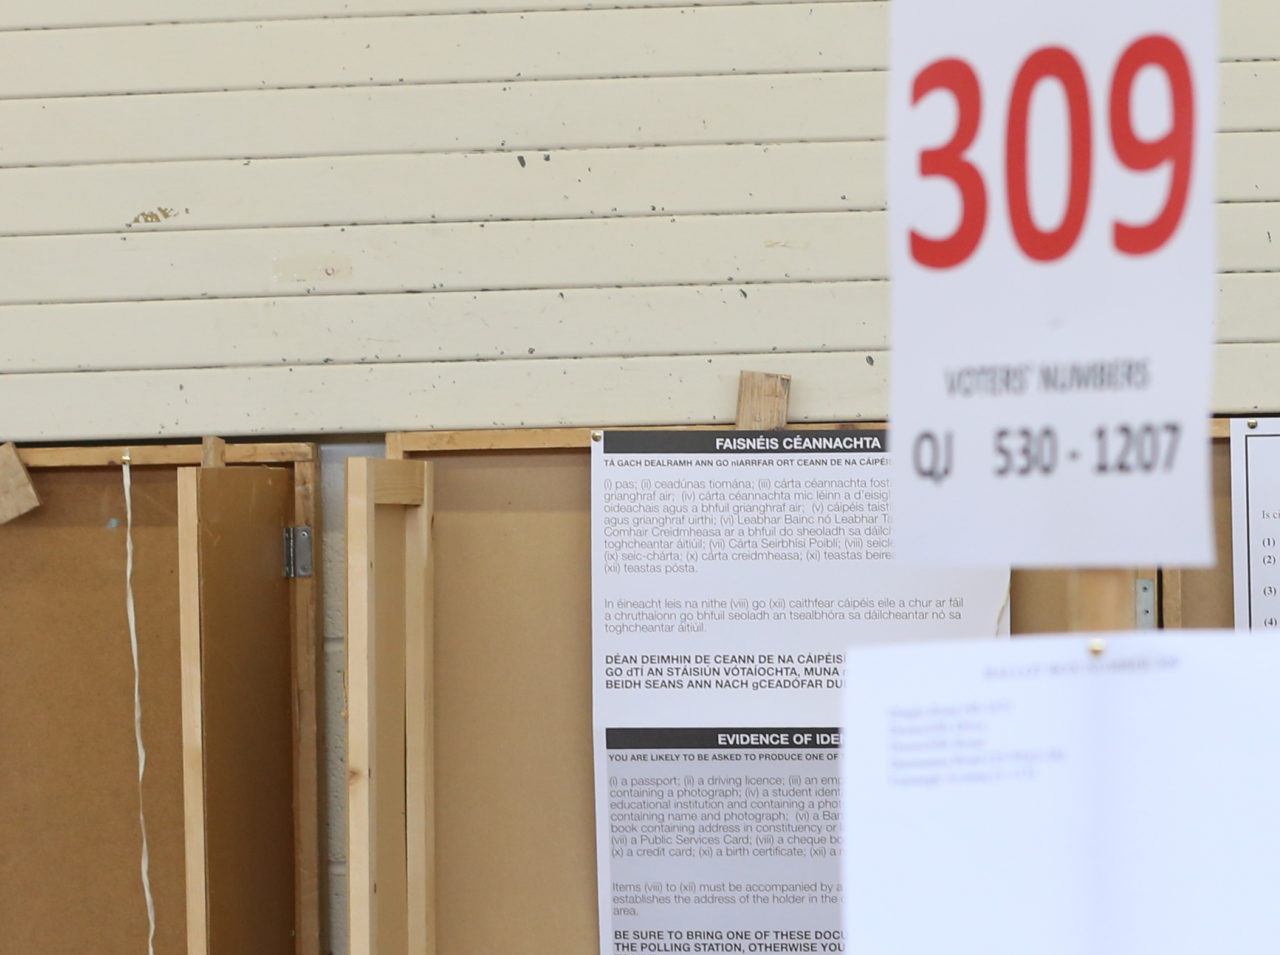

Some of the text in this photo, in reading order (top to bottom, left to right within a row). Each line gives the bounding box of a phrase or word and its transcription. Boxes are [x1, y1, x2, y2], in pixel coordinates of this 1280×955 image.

[908, 32, 1196, 272] 309
[945, 357, 1151, 397] VOTERS' NUMBERS
[715, 435, 881, 450] FAISNÉIS CÉANNACHTA
[913, 430, 953, 484] QJ
[992, 428, 1057, 478] 530
[1092, 422, 1181, 474] 1207
[604, 458, 614, 467] TÁ
[776, 459, 794, 467] ORT
[796, 459, 827, 467] CEANN
[1261, 510, 1270, 519] Is
[1262, 536, 1275, 548] (1)
[623, 563, 661, 573] teastas
[605, 652, 793, 665] DÉAN DEIMHIN DE CEANN DE NA
[605, 667, 623, 677] GO
[647, 667, 663, 677] AN
[666, 664, 720, 677] STÁISIÚN
[723, 664, 800, 678] VÓTAÍOCHTA,
[803, 666, 839, 676] MUNA
[605, 676, 822, 691] BEIDH SEANS ANN NACH gCEADÓFAR
[717, 734, 811, 745] EVIDENCE OF
[608, 754, 627, 762] YOU
[630, 754, 648, 762] ARE
[650, 754, 680, 762] LIKELY
[682, 754, 695, 762] TO
[697, 754, 709, 762] BE
[706, 776, 742, 788] driving
[612, 895, 838, 904] establishes the address of the holder in the
[612, 908, 639, 916] area.
[614, 930, 811, 940] BE SURE TO BRING ONE OF THESE
[614, 942, 637, 952] THE
[640, 942, 690, 952] POLLING
[694, 942, 744, 954] STATION,
[748, 942, 817, 952] OTHERWISE
